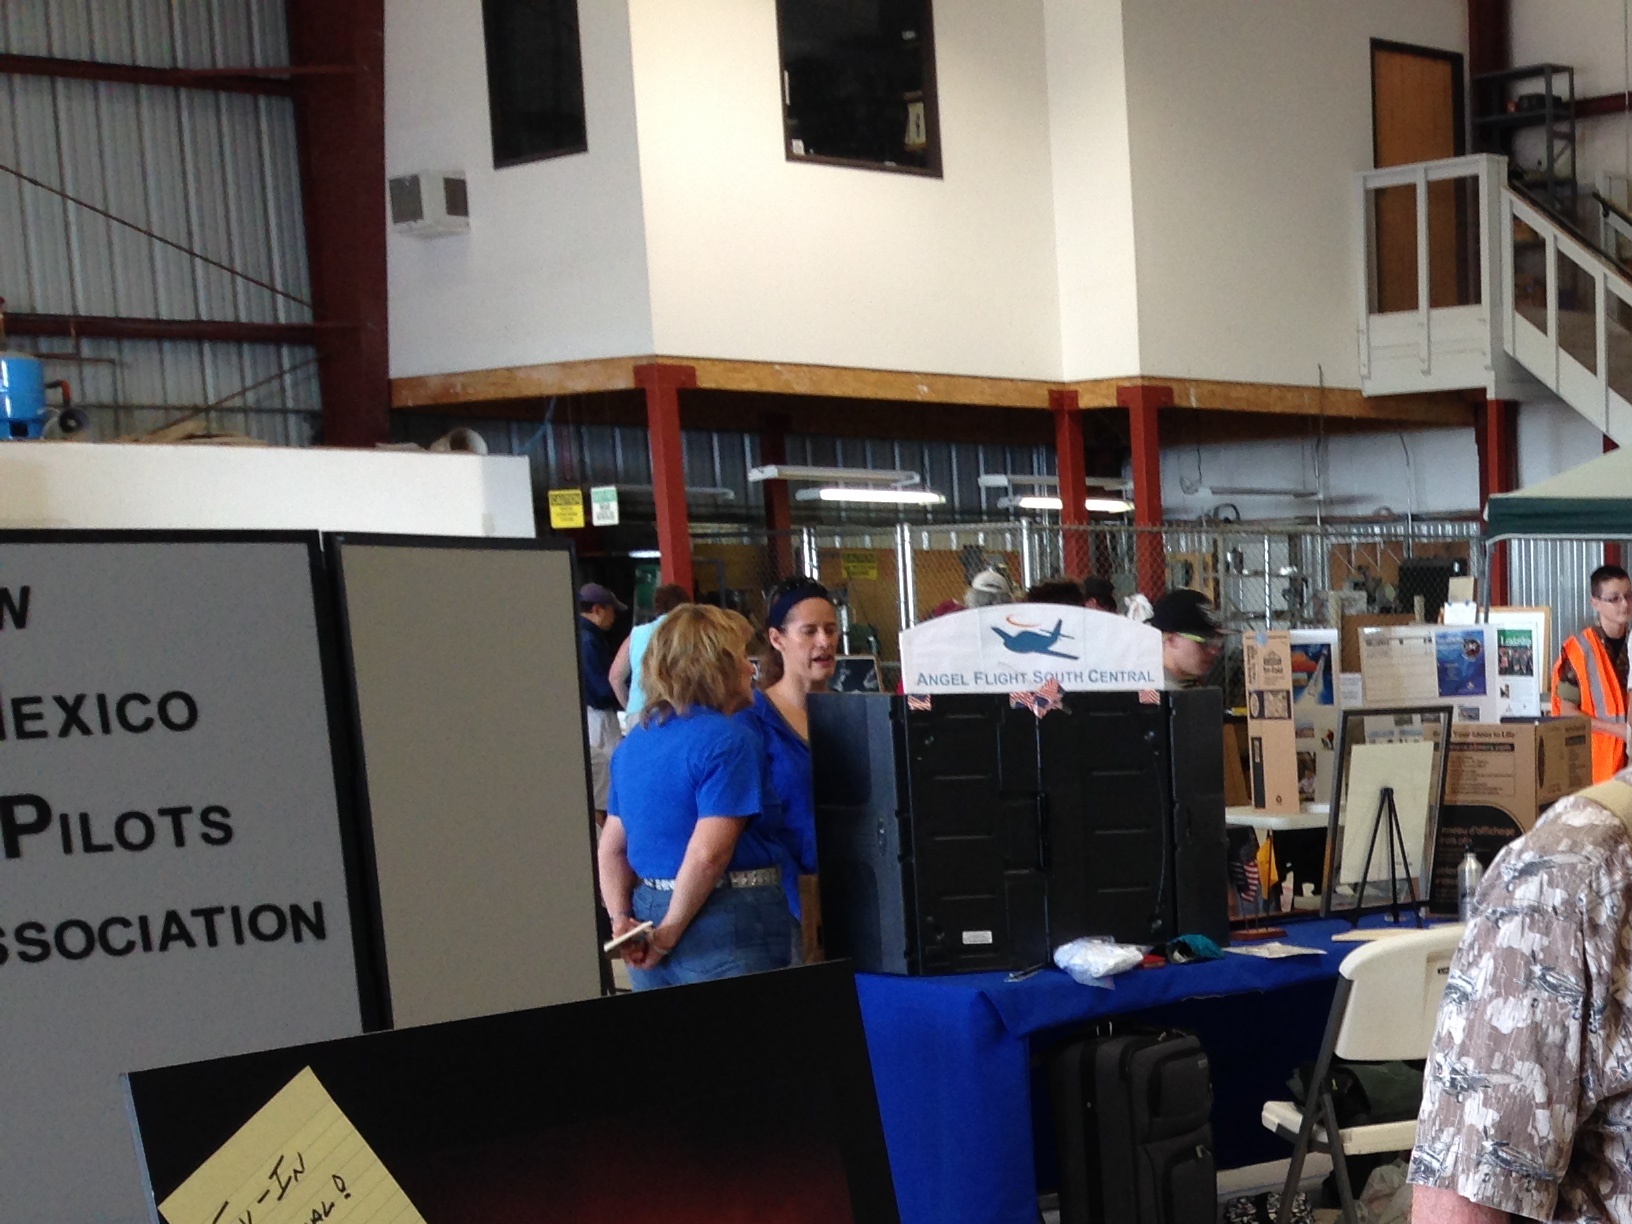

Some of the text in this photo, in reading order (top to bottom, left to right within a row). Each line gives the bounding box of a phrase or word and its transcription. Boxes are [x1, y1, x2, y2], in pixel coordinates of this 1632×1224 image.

[917, 669, 1155, 686] ANGEL FLIGHT SOUTH CENTRAL
[0, 690, 198, 742] EXICO
[0, 901, 327, 965] SOCIATION
